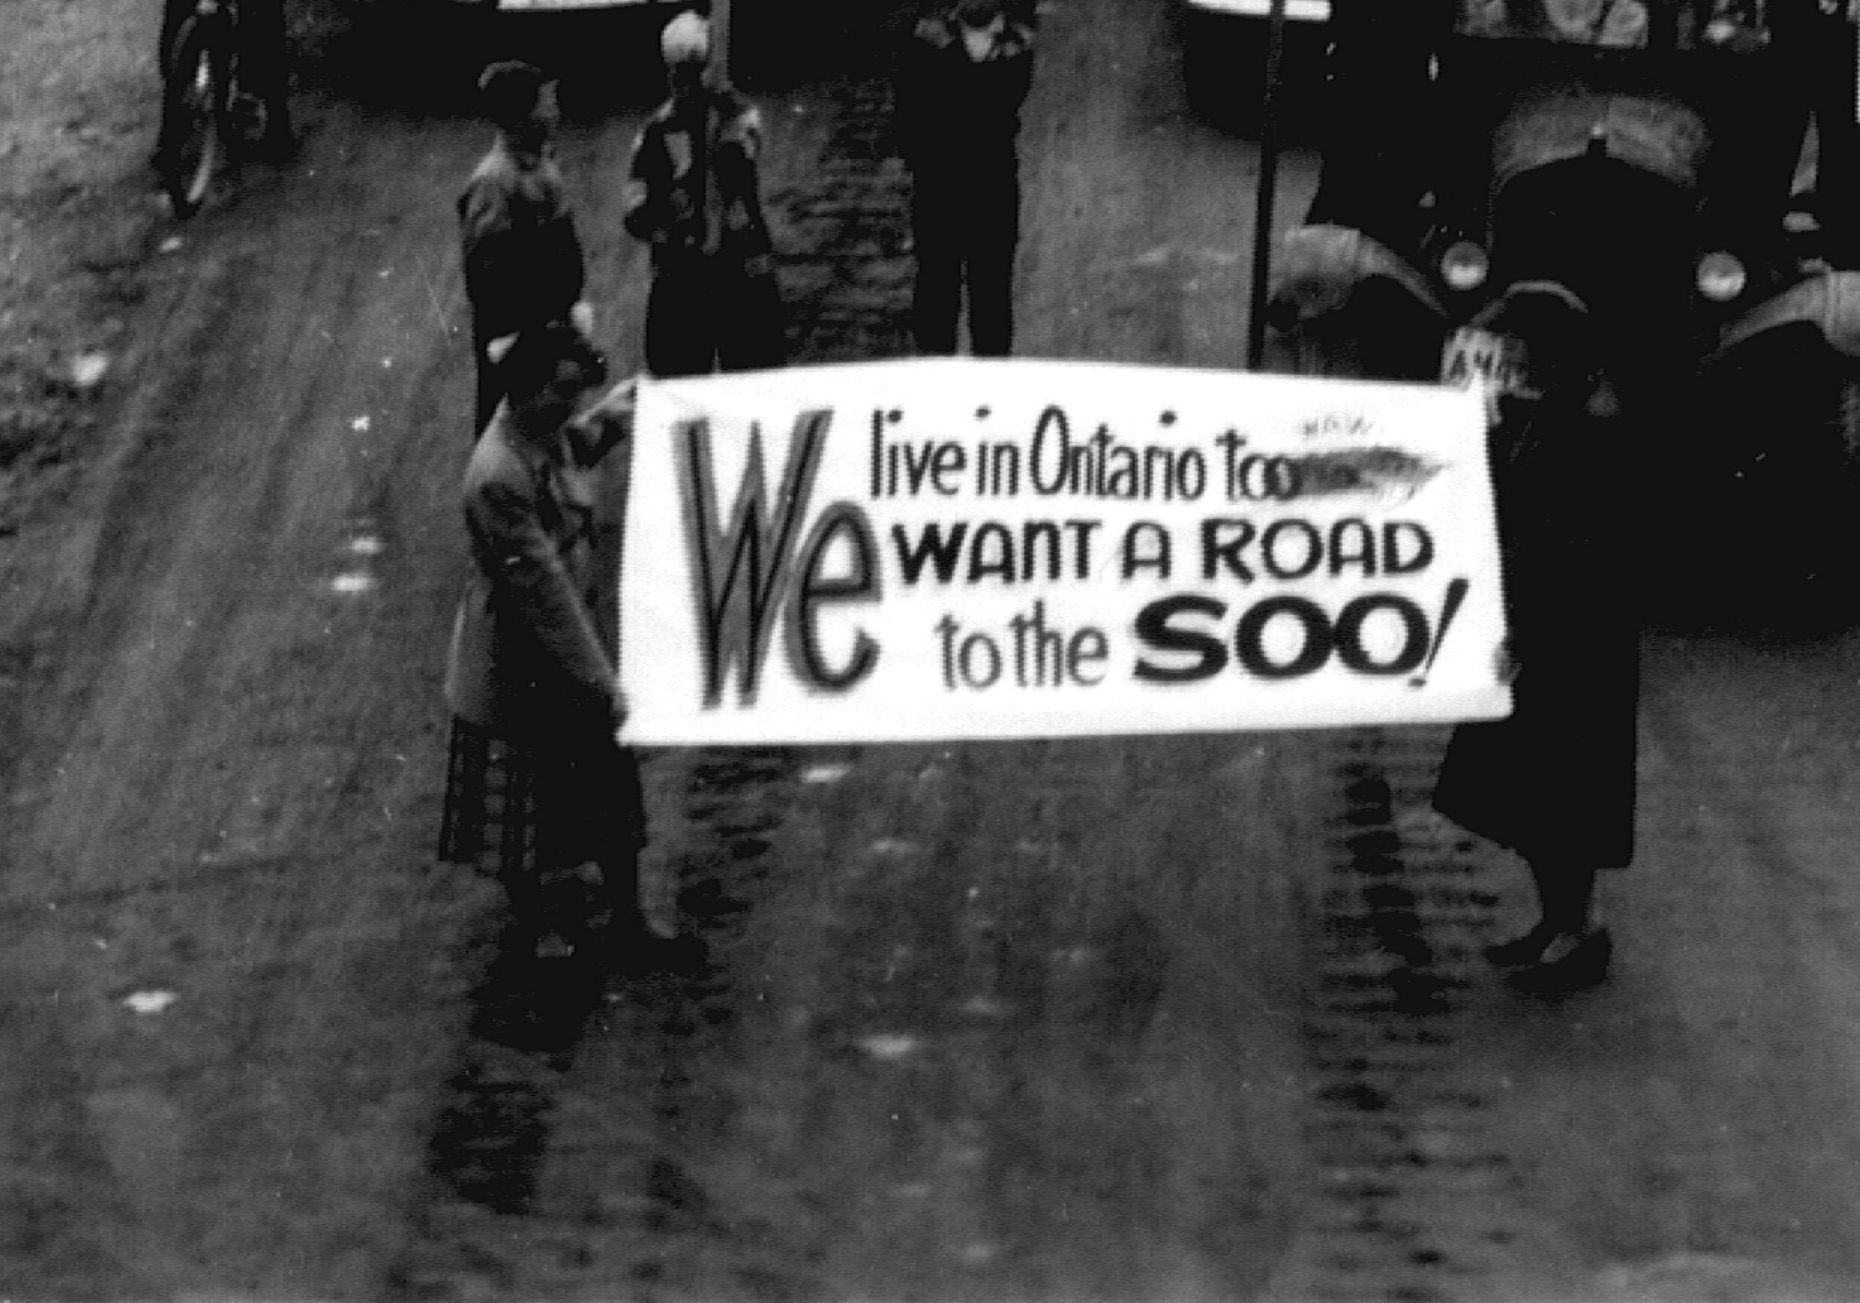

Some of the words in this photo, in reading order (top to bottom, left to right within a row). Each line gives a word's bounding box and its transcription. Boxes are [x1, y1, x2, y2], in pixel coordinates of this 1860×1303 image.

[869, 409, 967, 500] live
[974, 406, 1020, 499] in
[1029, 405, 1206, 501] Ontario
[671, 408, 883, 710] We
[892, 520, 1103, 585] WANT
[1122, 521, 1173, 580] A
[1200, 518, 1435, 583] ROAD
[936, 614, 1001, 690] to
[1012, 599, 1110, 689] the
[1131, 578, 1470, 688] SOO!
